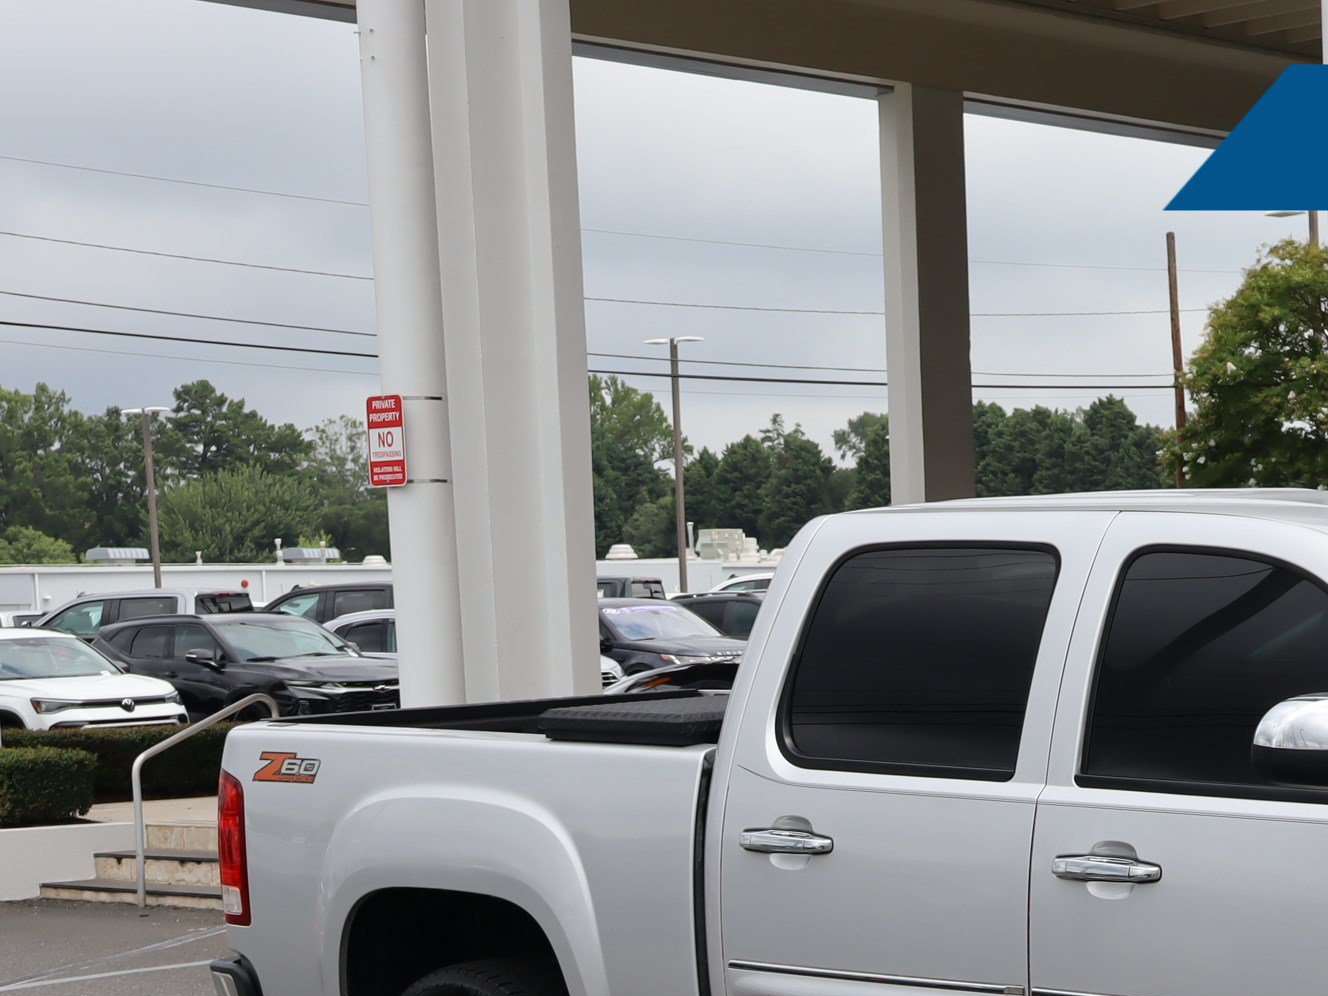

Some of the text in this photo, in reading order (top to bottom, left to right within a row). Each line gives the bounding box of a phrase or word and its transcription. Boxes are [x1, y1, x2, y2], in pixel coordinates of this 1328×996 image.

[372, 399, 396, 409] PRIVATE
[369, 411, 400, 422] PROPERTY
[378, 431, 394, 447] NO
